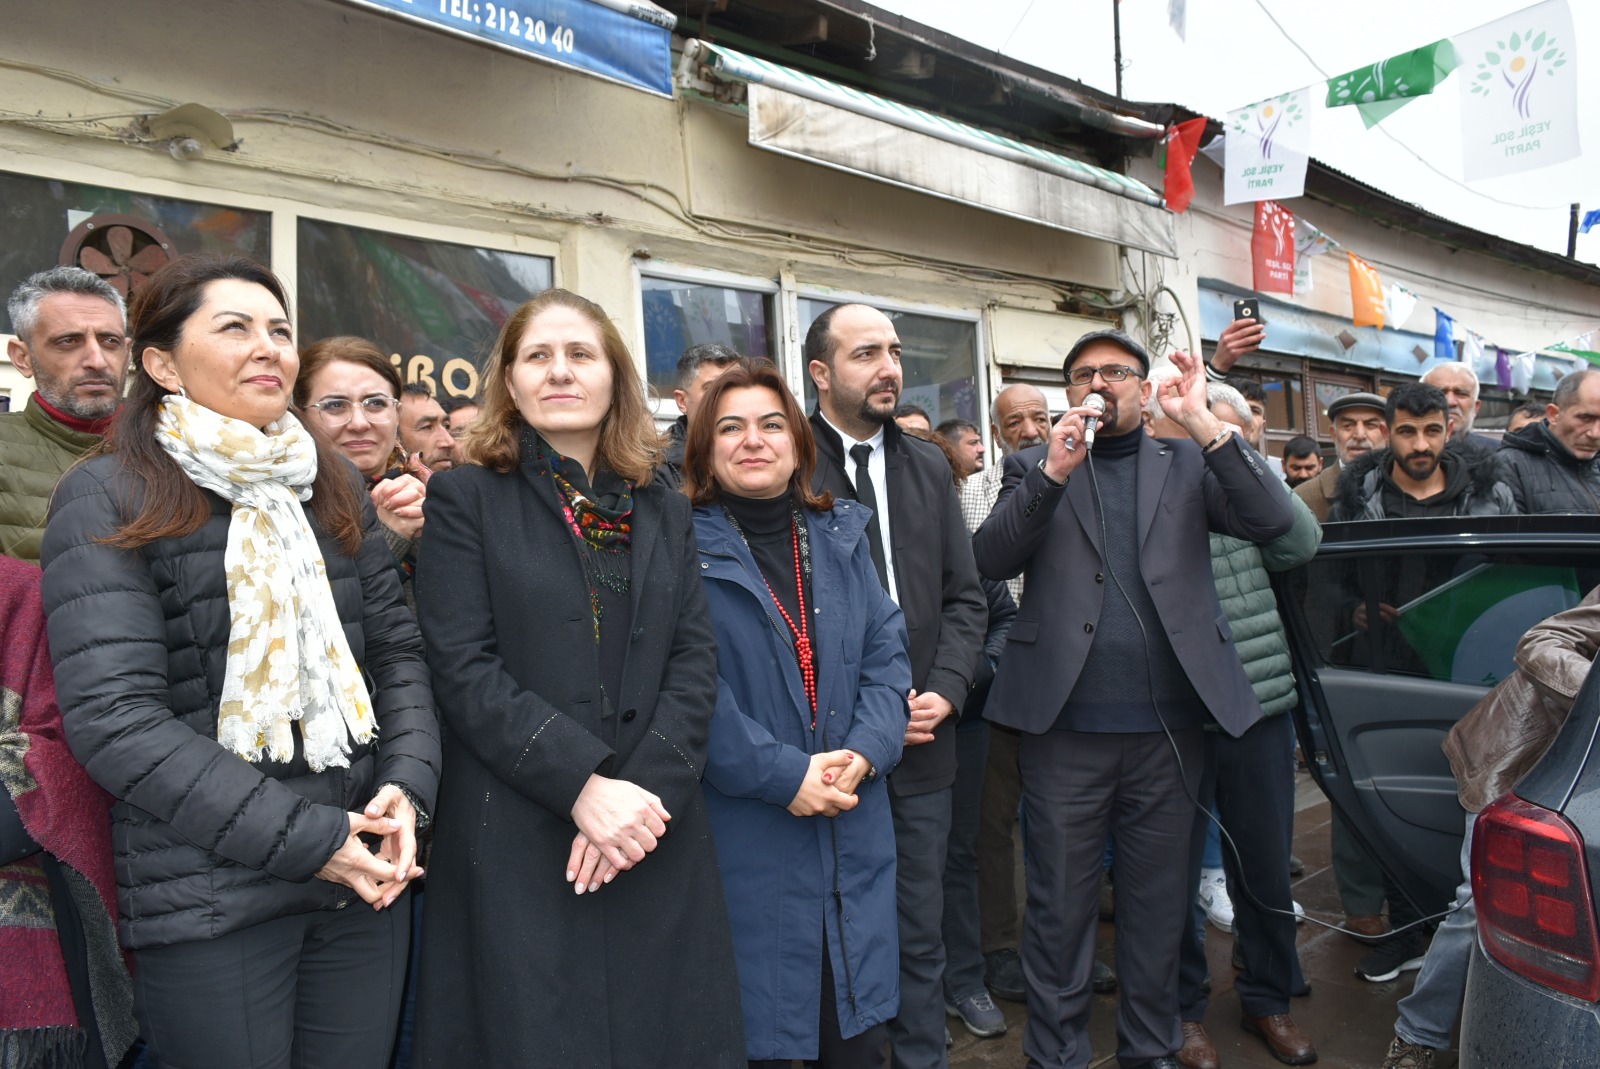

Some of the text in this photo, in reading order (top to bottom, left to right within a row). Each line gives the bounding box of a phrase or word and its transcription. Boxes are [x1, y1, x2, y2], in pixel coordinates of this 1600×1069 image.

[485, 2, 520, 36] 212
[523, 16, 546, 45] 20
[551, 25, 574, 54] 40
